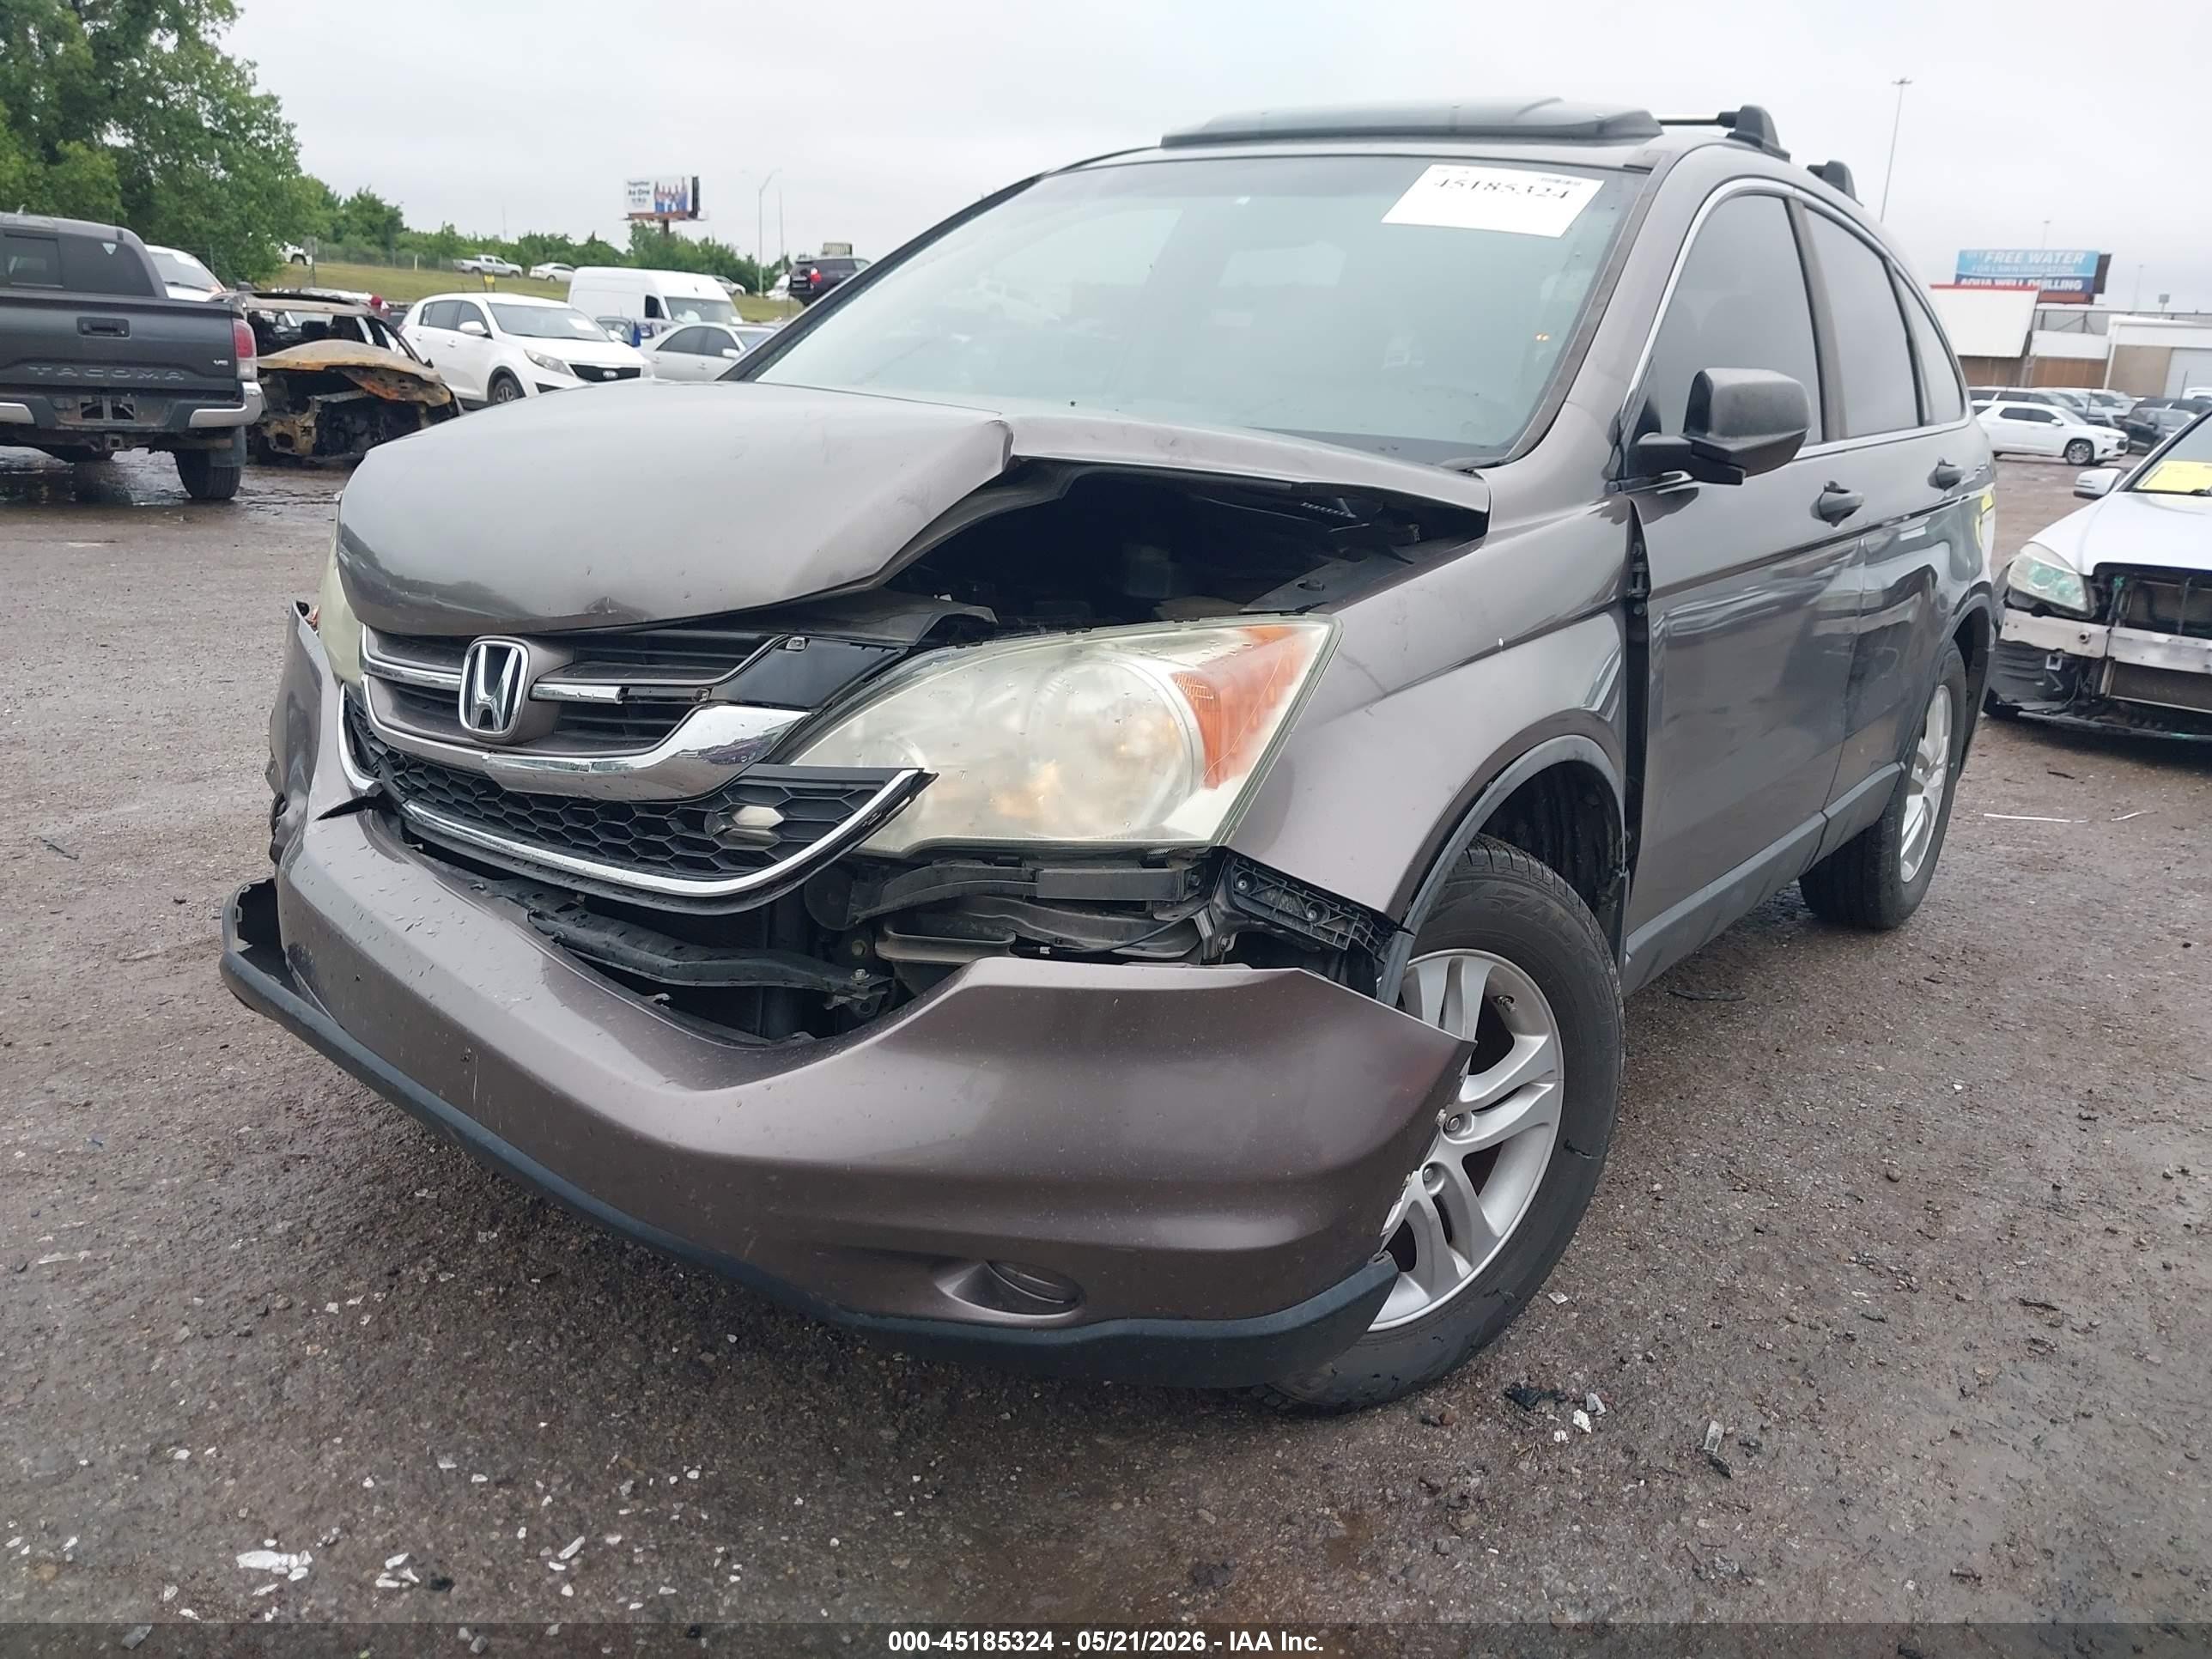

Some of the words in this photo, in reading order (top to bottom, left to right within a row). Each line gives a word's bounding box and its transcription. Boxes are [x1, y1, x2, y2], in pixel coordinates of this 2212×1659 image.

[1984, 251, 2024, 264] FREE
[2027, 251, 2087, 264] WATER
[28, 367, 185, 380] TACOMA
